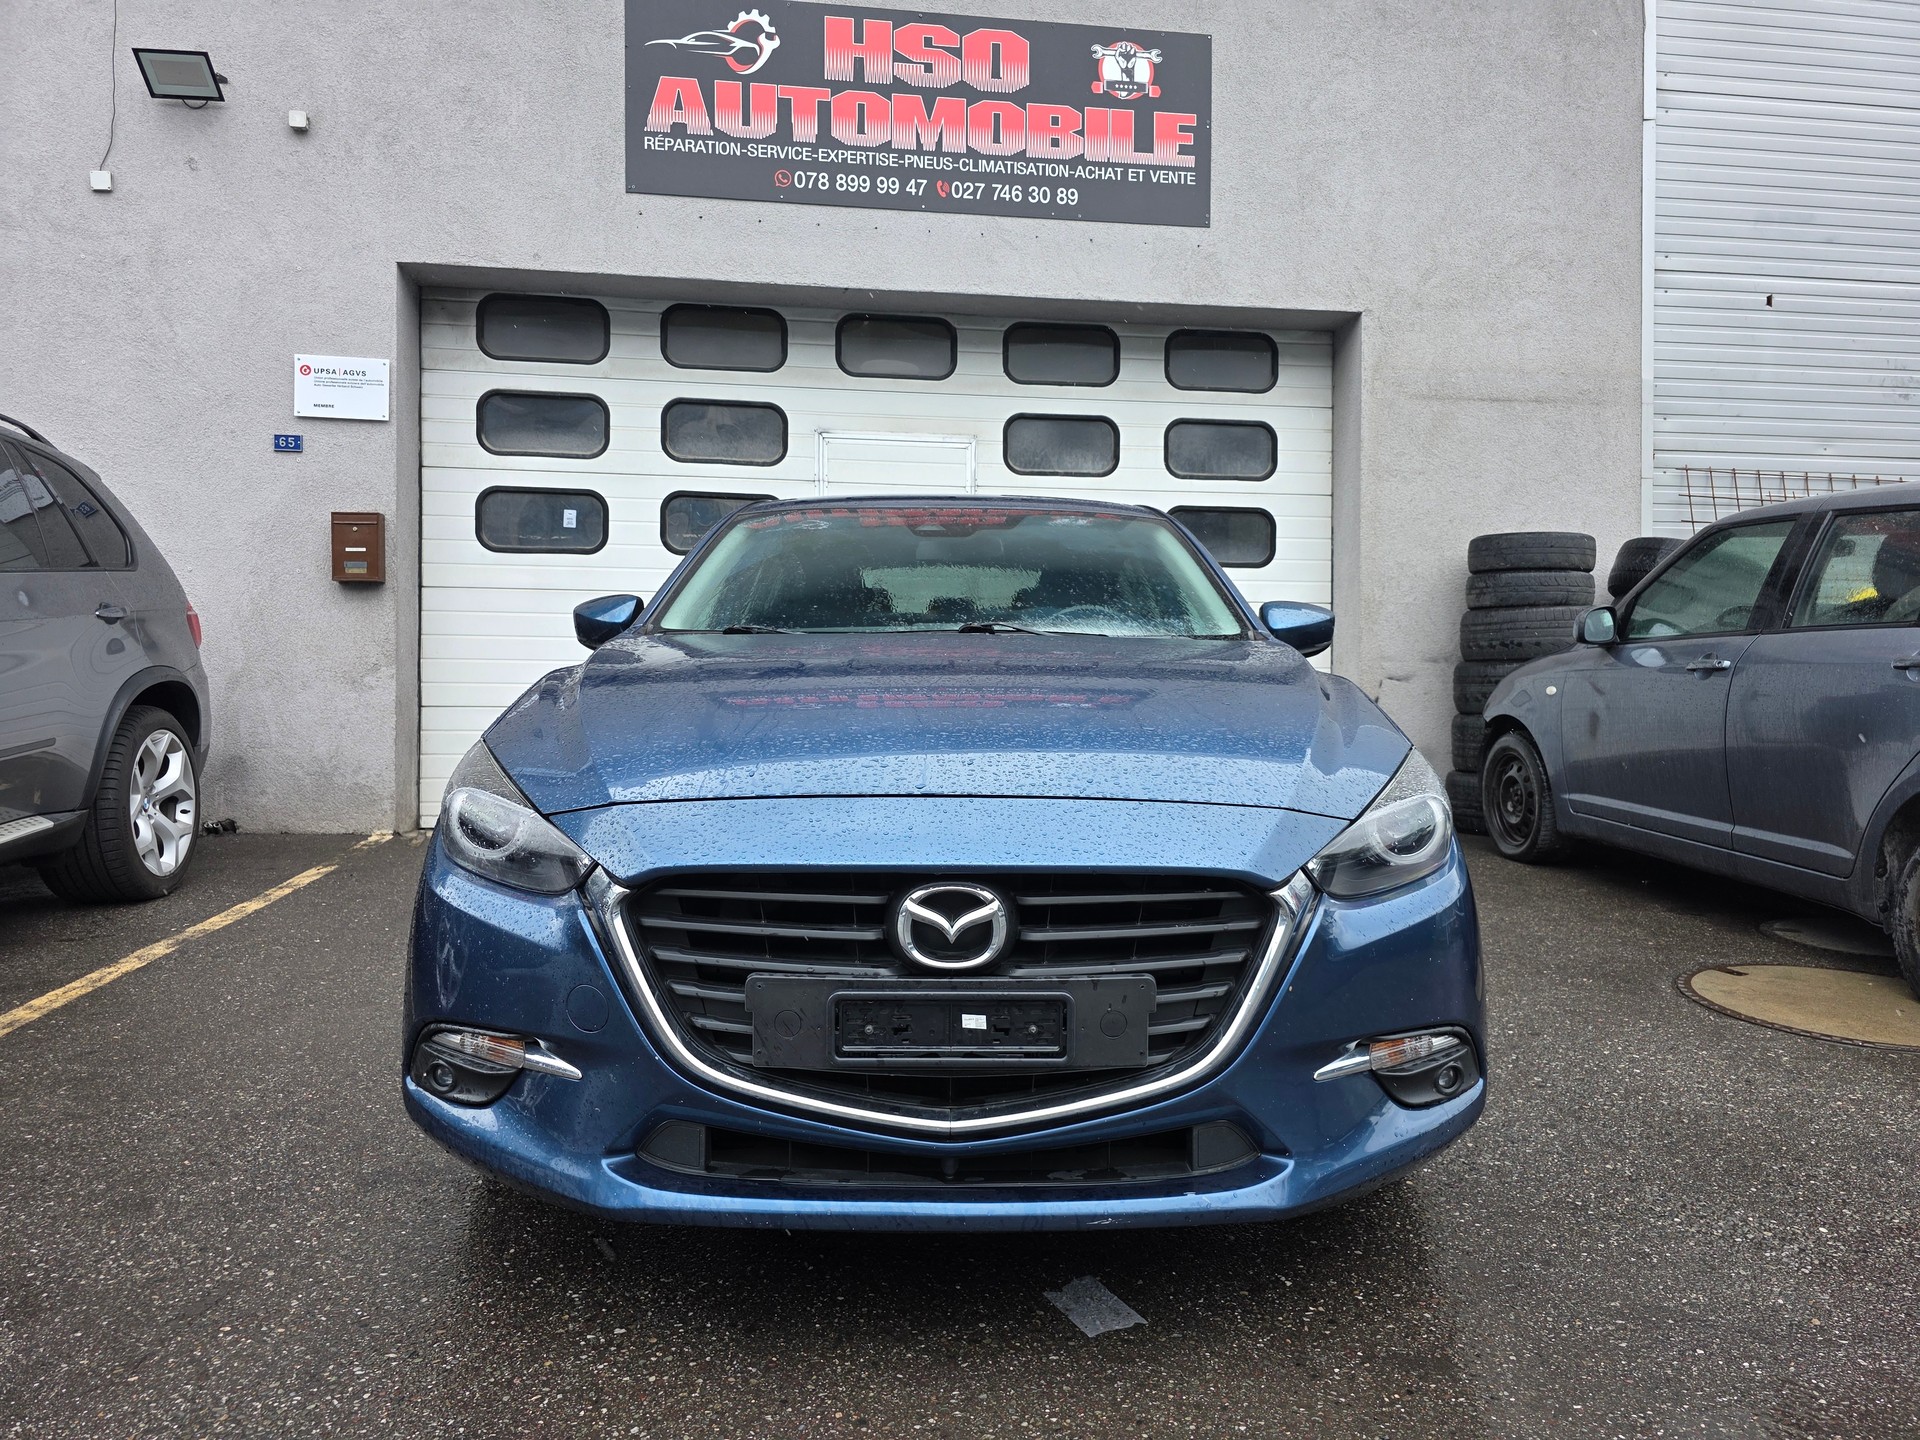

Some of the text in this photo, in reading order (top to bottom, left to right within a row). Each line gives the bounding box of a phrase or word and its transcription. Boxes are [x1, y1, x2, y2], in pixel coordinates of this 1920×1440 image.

[824, 15, 1030, 94] HSO
[643, 75, 1197, 168] AUTOMOBILE
[643, 134, 1196, 185] RÉPARATION-SERVICE-EXPERTISE-PNEUS-CLIMATISATION-ACHAT ET VENTE
[793, 170, 1079, 206] 078 899 99 47 027 746 30 89
[313, 367, 367, 377] UPSA AGVS
[279, 436, 295, 448] 65
